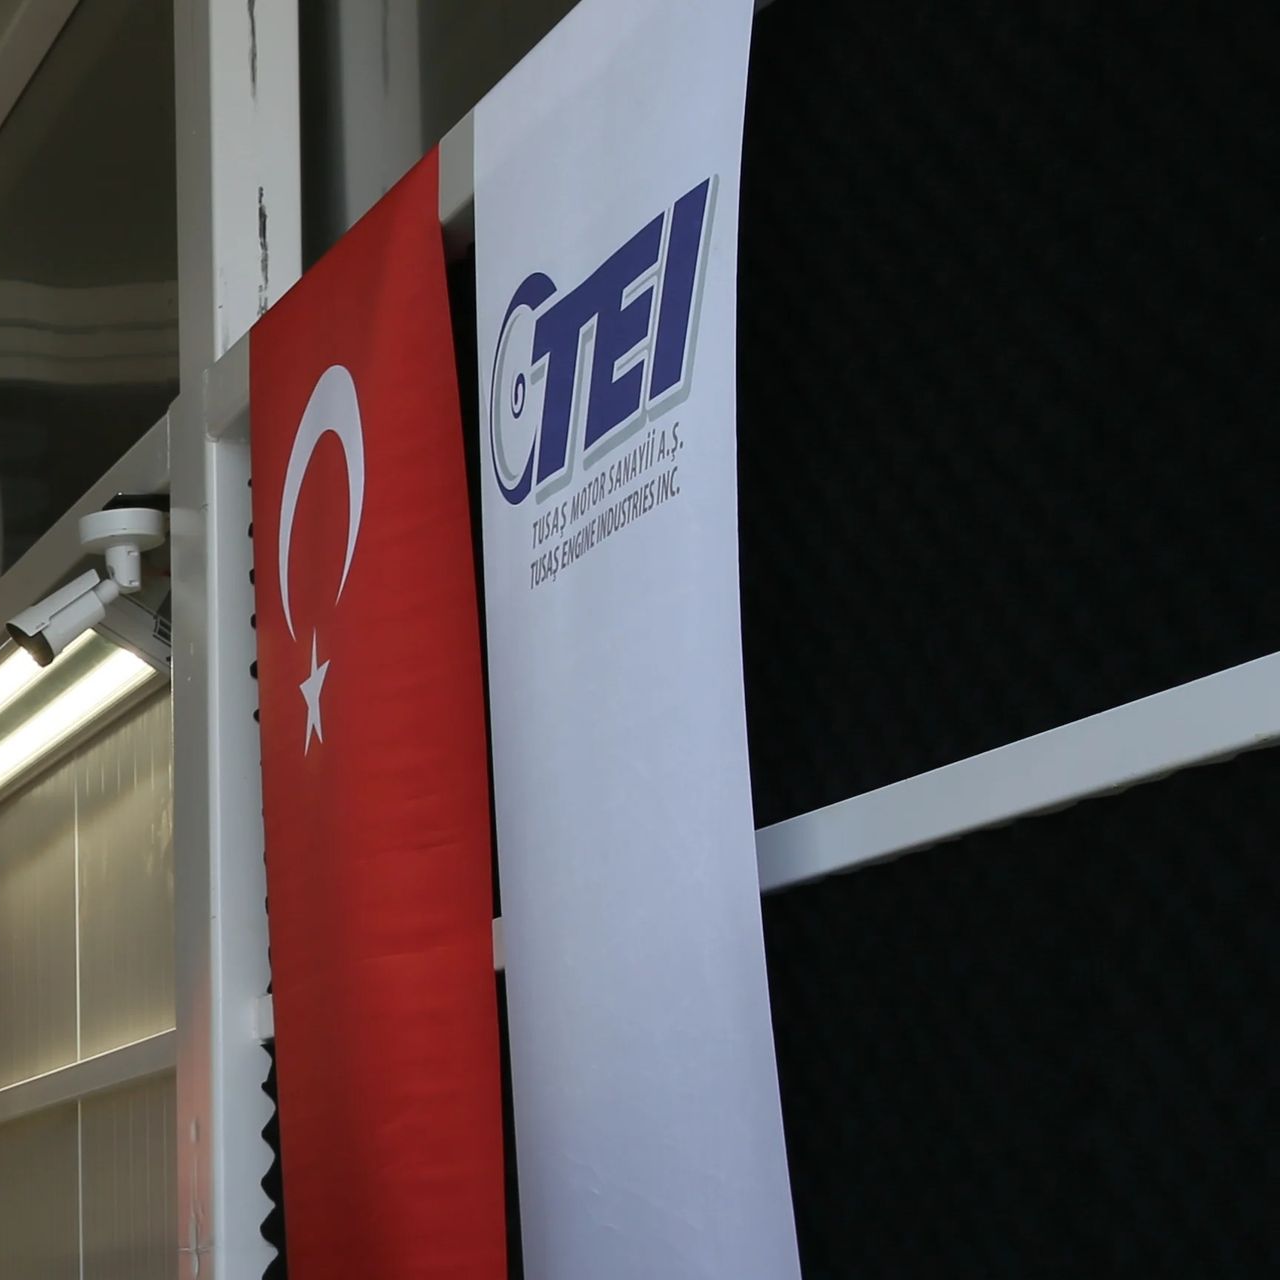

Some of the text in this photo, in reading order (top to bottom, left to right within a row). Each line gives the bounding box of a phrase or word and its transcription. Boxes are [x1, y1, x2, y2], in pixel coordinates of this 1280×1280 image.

[531, 176, 711, 487] TEI
[530, 465, 681, 590] TUSAŞ ENGINE INDUSTRIES INC.
[532, 421, 684, 549] TUSAŞ MOTOR SANAYİİ A.Ş.
